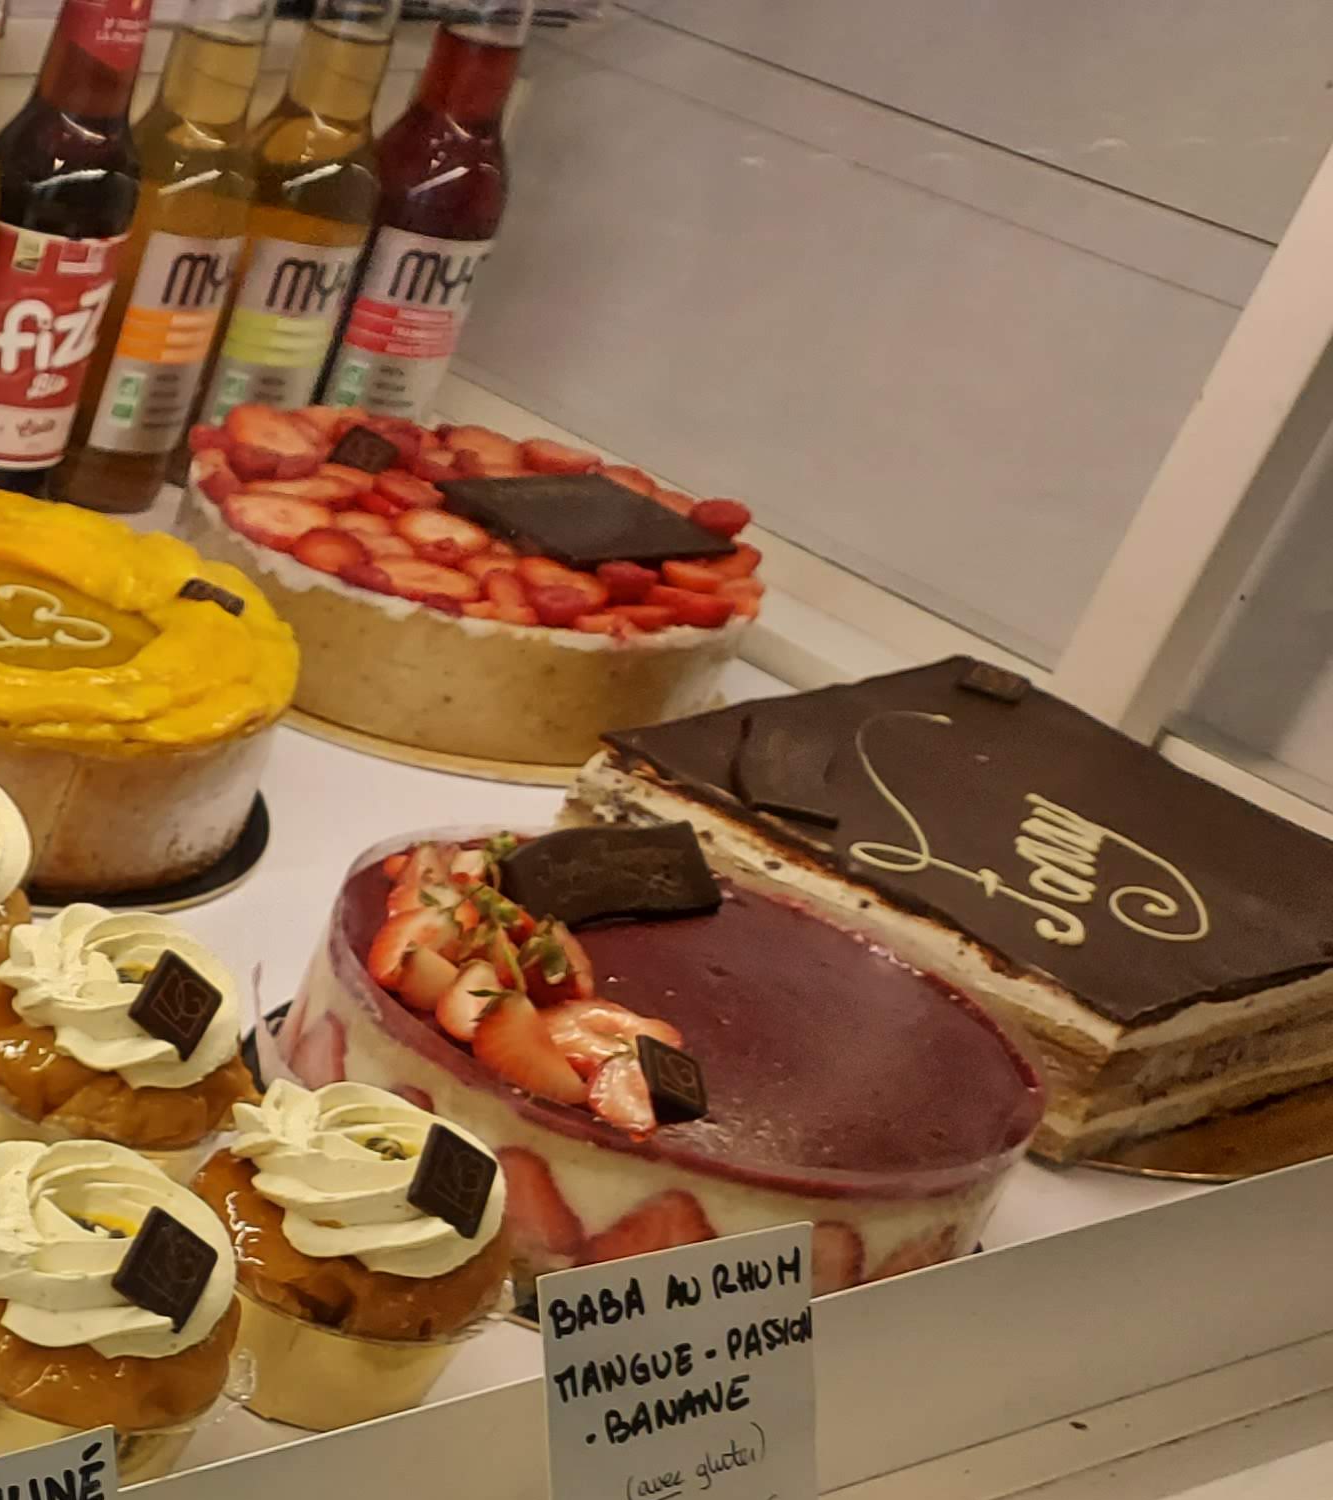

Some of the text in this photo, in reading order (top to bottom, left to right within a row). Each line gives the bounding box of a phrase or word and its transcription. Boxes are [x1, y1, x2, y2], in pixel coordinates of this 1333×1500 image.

[548, 1246, 802, 1339] BABA AU RHUM
[553, 1342, 694, 1404] MANGUE
[726, 1304, 816, 1361] PASSION
[604, 1374, 751, 1445] BANANE
